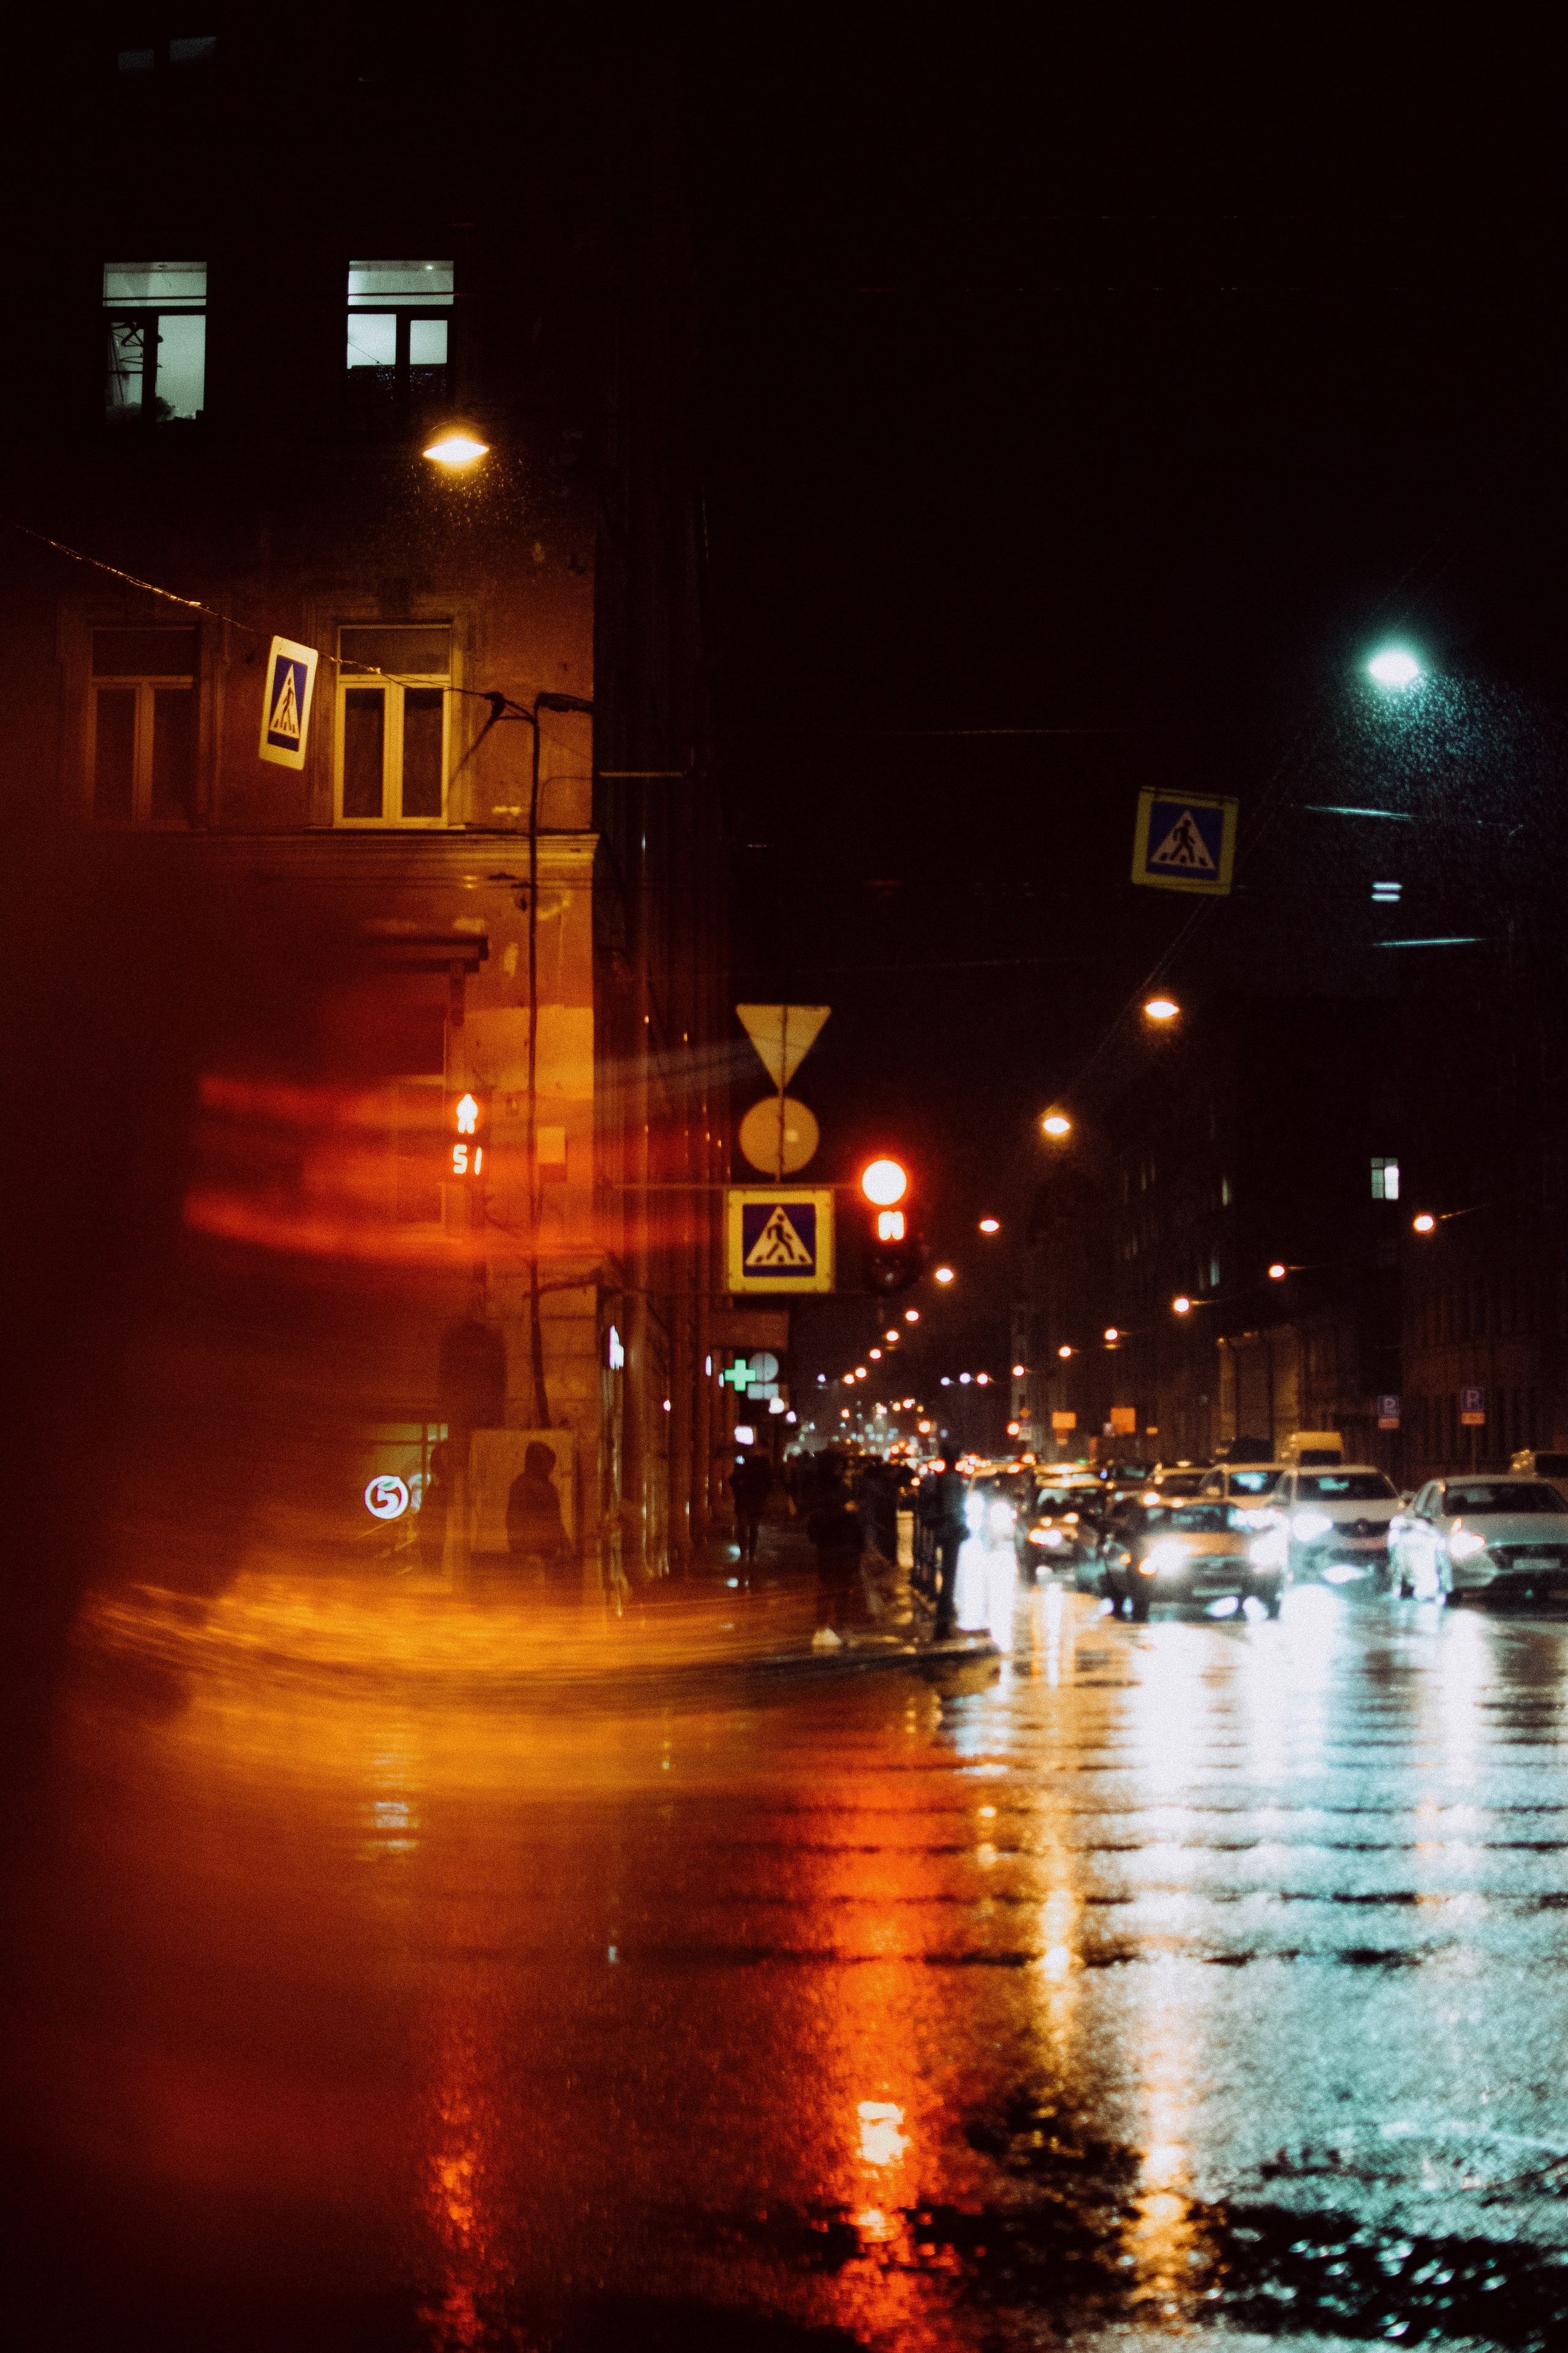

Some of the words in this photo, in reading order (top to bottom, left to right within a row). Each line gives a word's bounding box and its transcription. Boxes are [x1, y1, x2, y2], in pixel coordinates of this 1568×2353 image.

[453, 1144, 482, 1175] 51
[1467, 1389, 1480, 1408] P
[372, 1477, 403, 1517] 5
